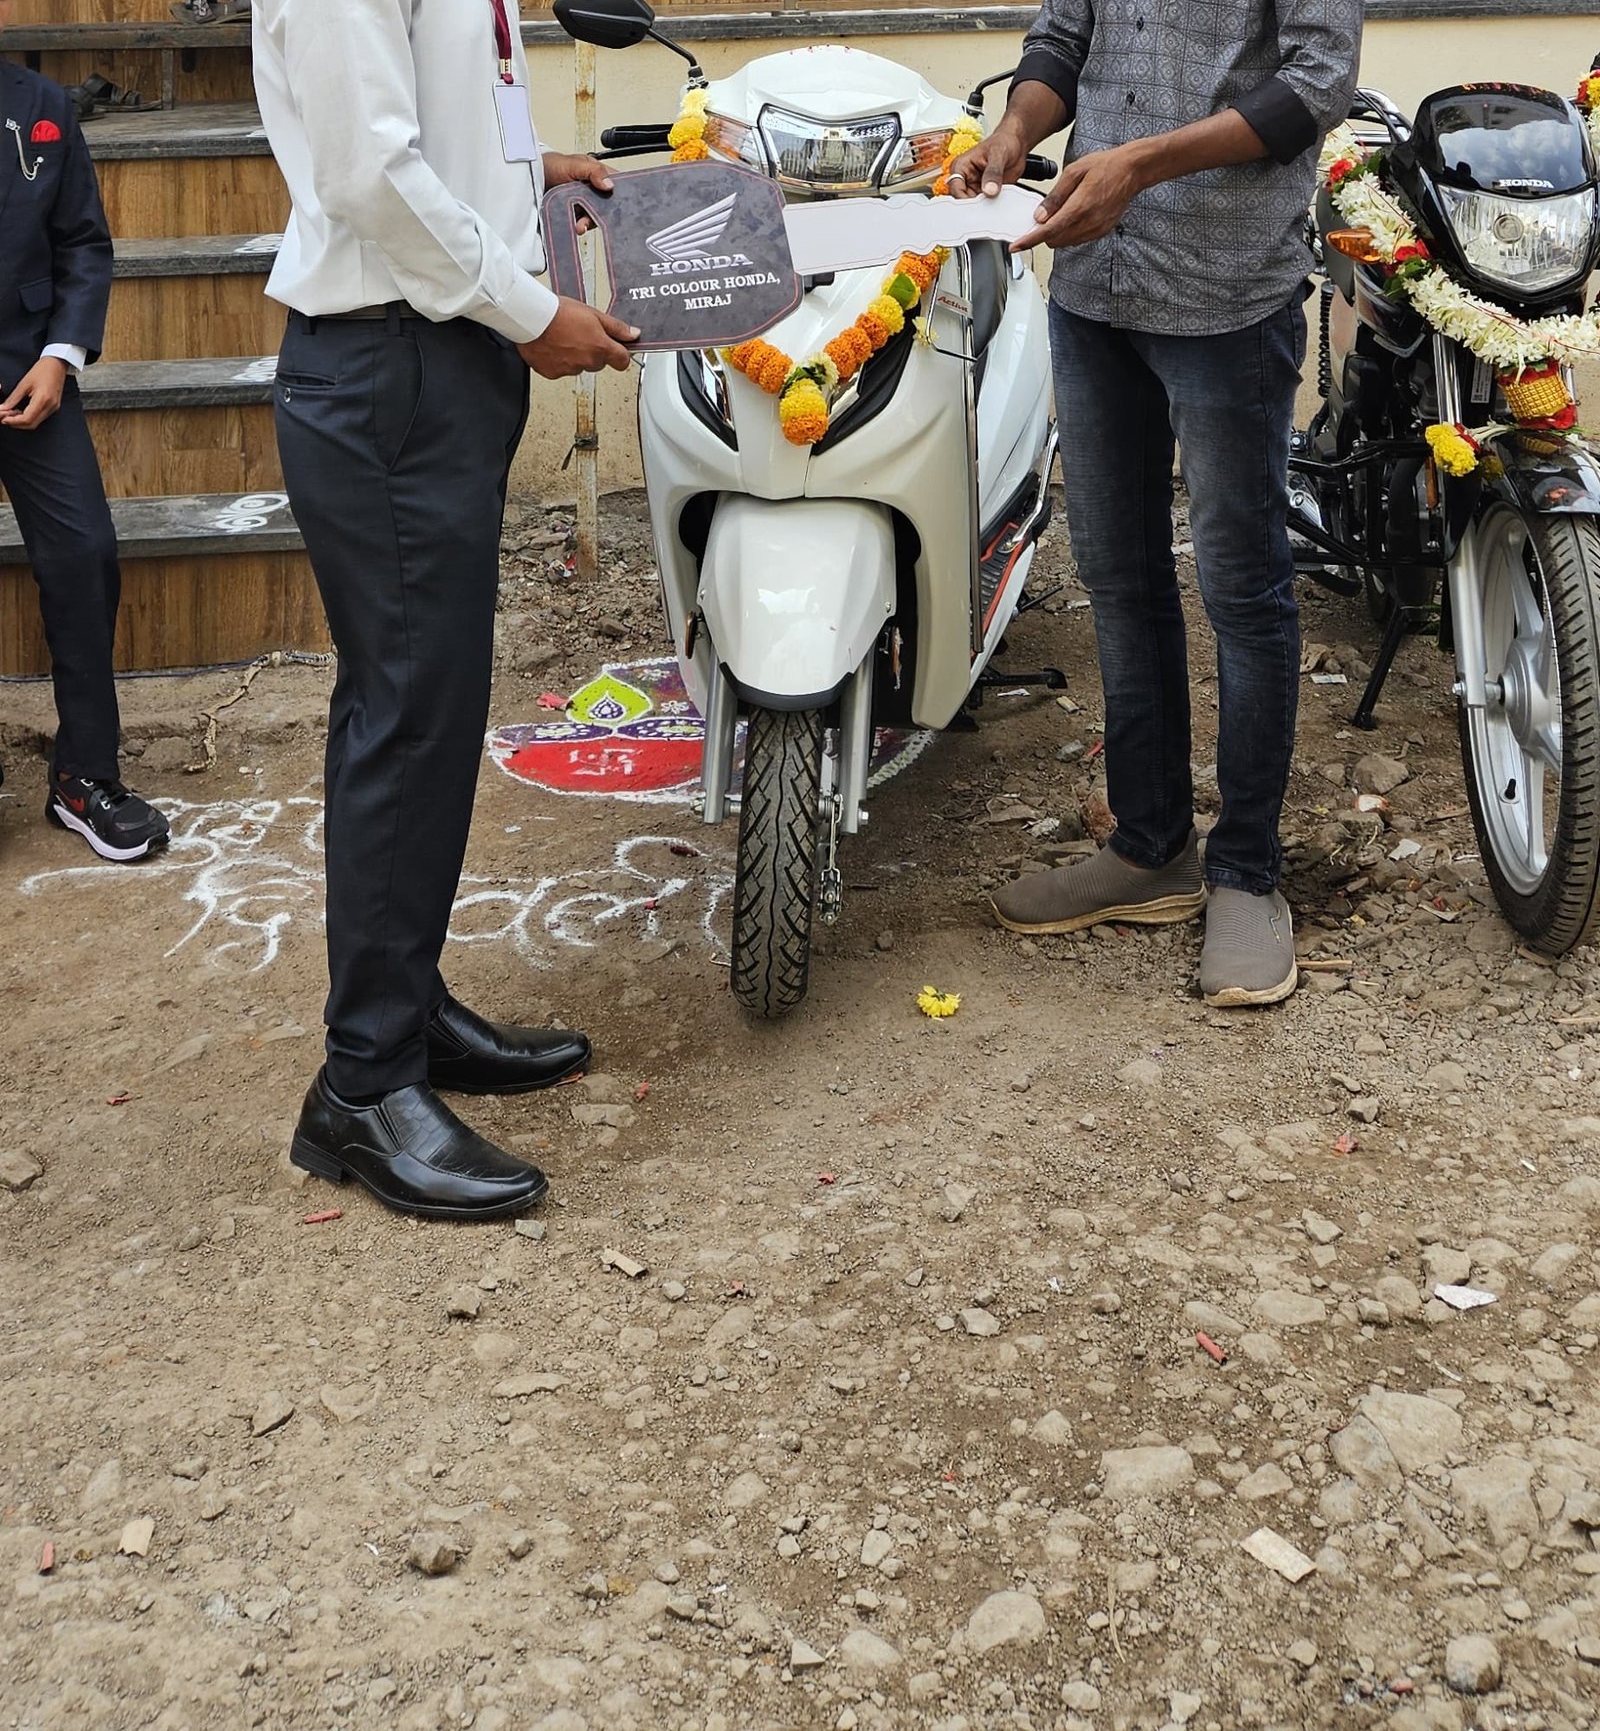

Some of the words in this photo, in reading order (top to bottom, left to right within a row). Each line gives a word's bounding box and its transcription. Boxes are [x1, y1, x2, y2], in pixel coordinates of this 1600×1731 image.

[1498, 178, 1555, 189] HONDA
[649, 252, 754, 277] HONDA
[629, 285, 656, 301] TRI
[659, 279, 720, 296] COLOUR
[724, 271, 781, 289] HONDA,
[684, 293, 732, 311] MIRAJ
[937, 295, 969, 313] Activa
